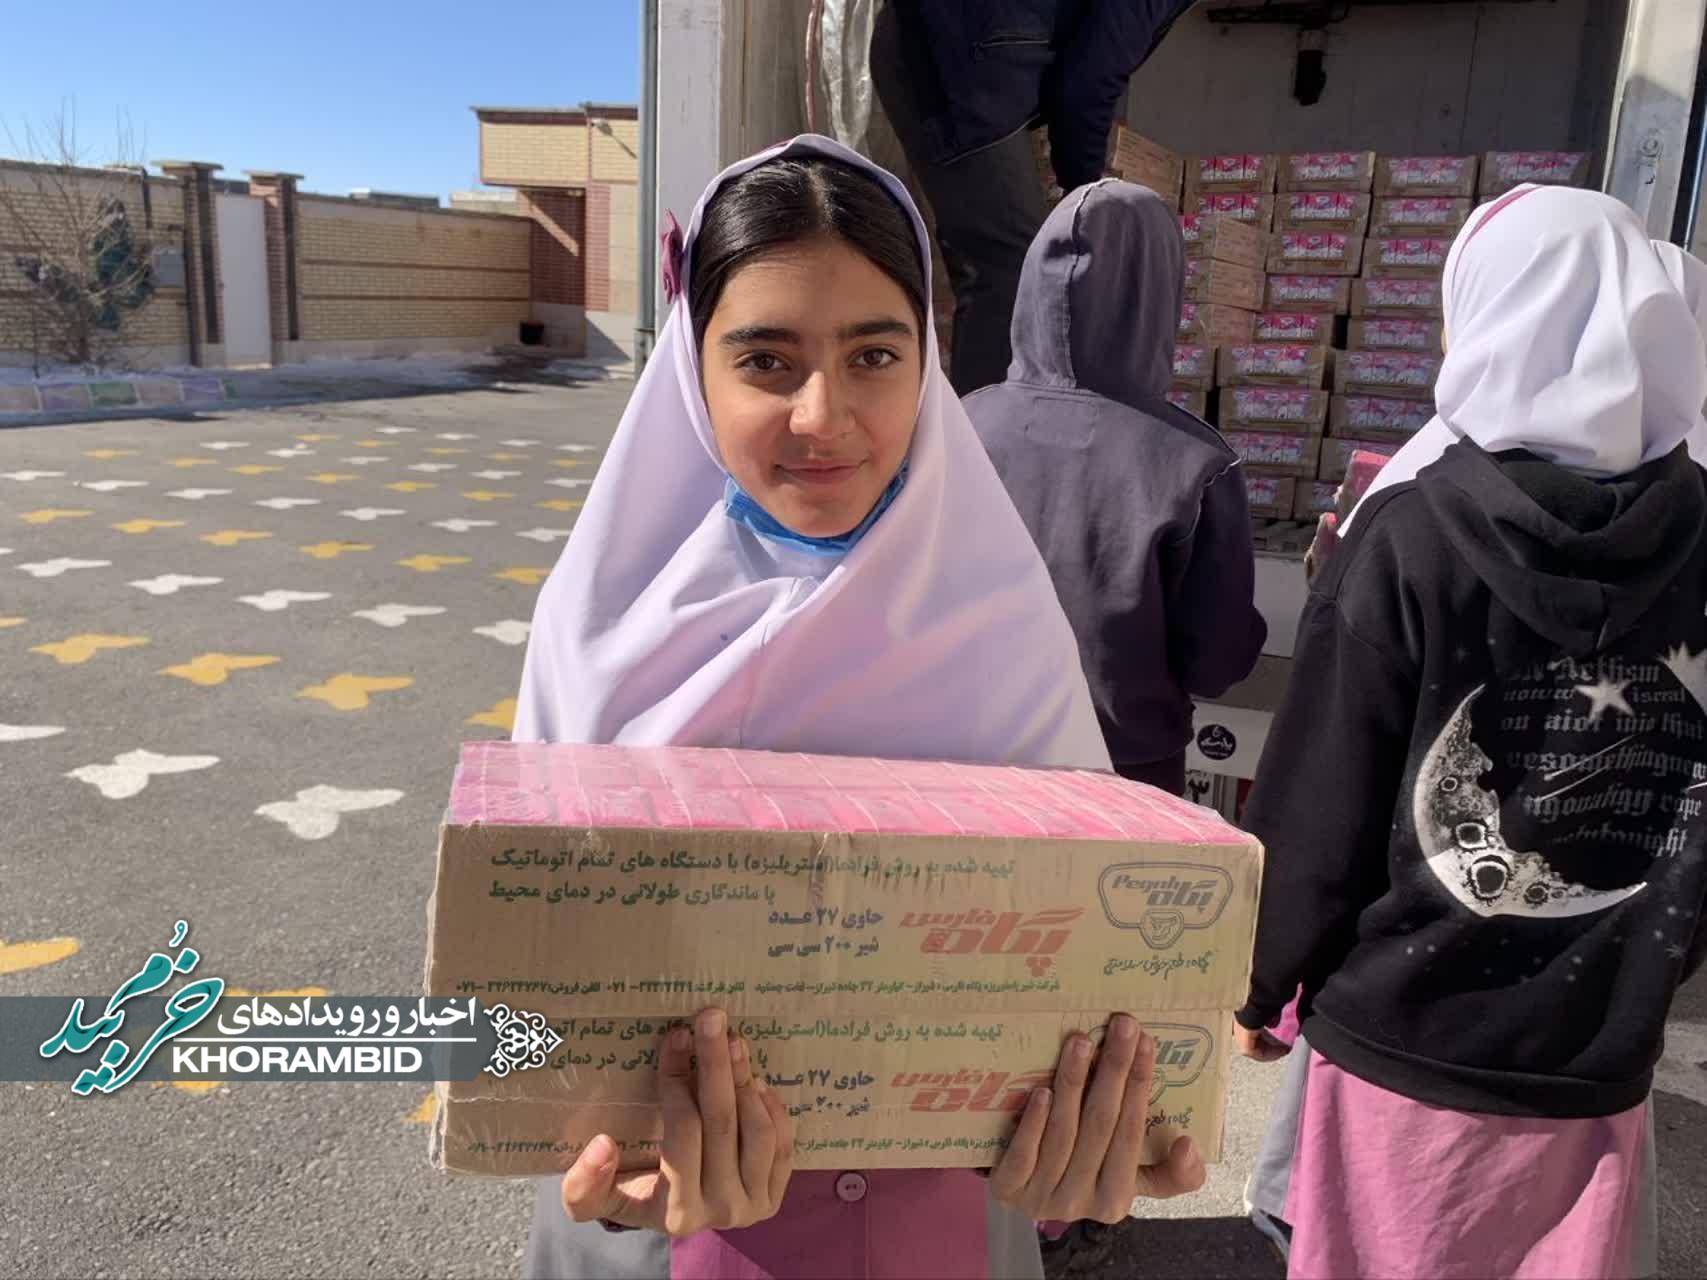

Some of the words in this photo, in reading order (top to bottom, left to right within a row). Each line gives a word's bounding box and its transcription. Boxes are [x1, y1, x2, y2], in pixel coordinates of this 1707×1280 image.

[490, 847, 574, 873] اتوماتیک
[577, 848, 616, 873] تمام
[619, 850, 655, 873] های
[660, 852, 723, 871] دستگاه
[488, 880, 541, 902] محیط
[546, 880, 591, 904] دمای
[596, 884, 617, 905] در
[620, 881, 681, 905] طولانی
[686, 883, 760, 905] ماندگاری
[816, 906, 839, 926] ۲۷
[841, 907, 884, 929] حاوی
[854, 936, 880, 959] شیر
[579, 1018, 614, 1040] تمام
[619, 1017, 652, 1041] های
[874, 1023, 912, 1042] روش
[915, 1024, 930, 1041] به
[934, 1022, 968, 1038] شده
[971, 1022, 1004, 1042] تهیه
[550, 1047, 593, 1070] دمای
[599, 1051, 617, 1070] در
[806, 1069, 832, 1088] ۲۷
[833, 1070, 875, 1091] حاوی
[846, 1097, 872, 1117] شیر
